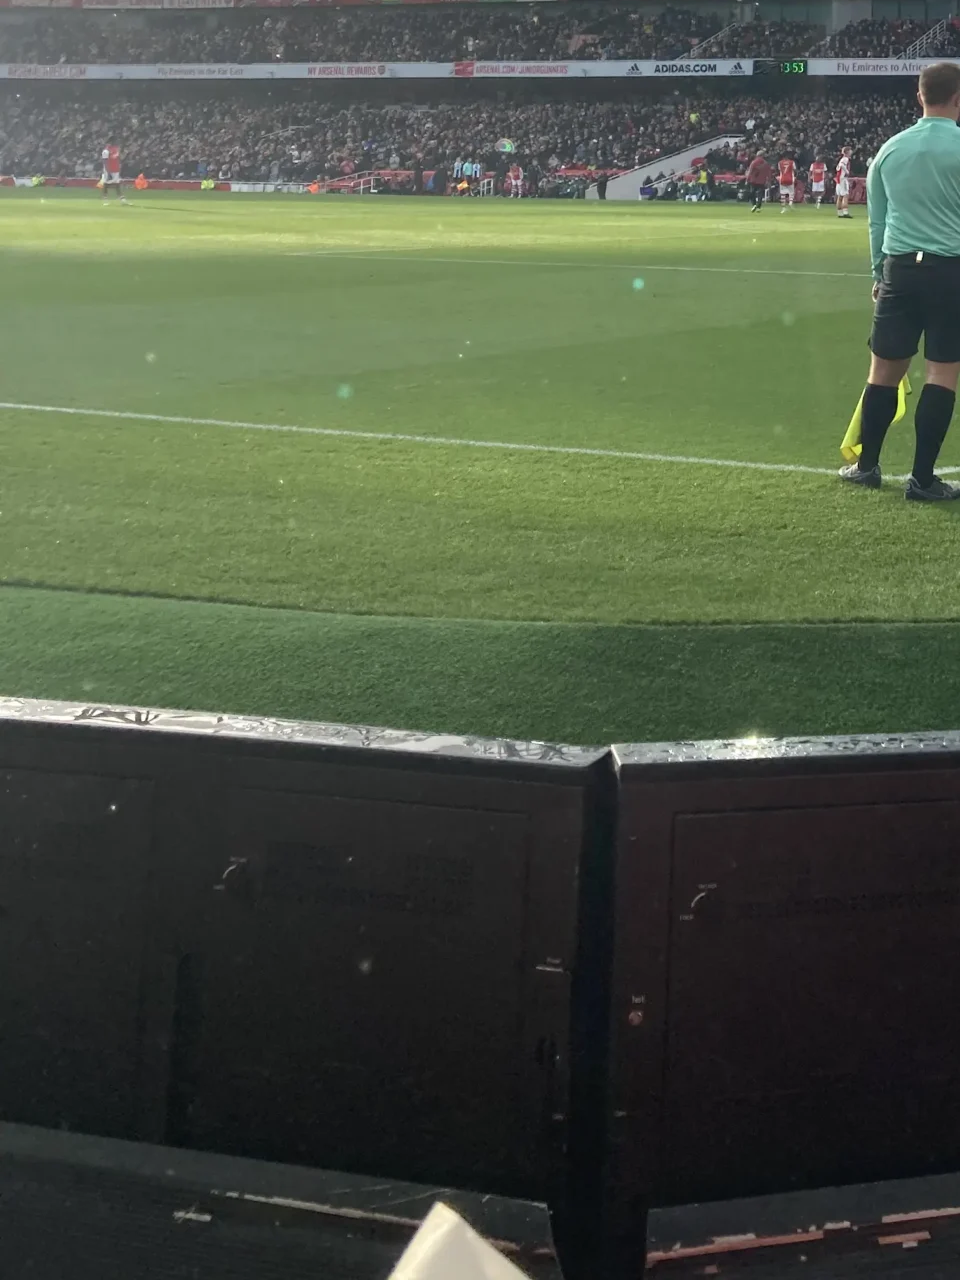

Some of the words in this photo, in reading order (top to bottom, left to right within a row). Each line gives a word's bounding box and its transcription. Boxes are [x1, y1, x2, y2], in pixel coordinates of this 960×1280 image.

[229, 66, 244, 75] East
[307, 66, 317, 76] MY
[318, 66, 346, 76] ARSENAL
[347, 65, 376, 75] REWARDS
[654, 64, 717, 73] ADIDAS.COM
[837, 63, 850, 74] Fly
[852, 62, 890, 72] Emirates
[891, 64, 900, 72] to
